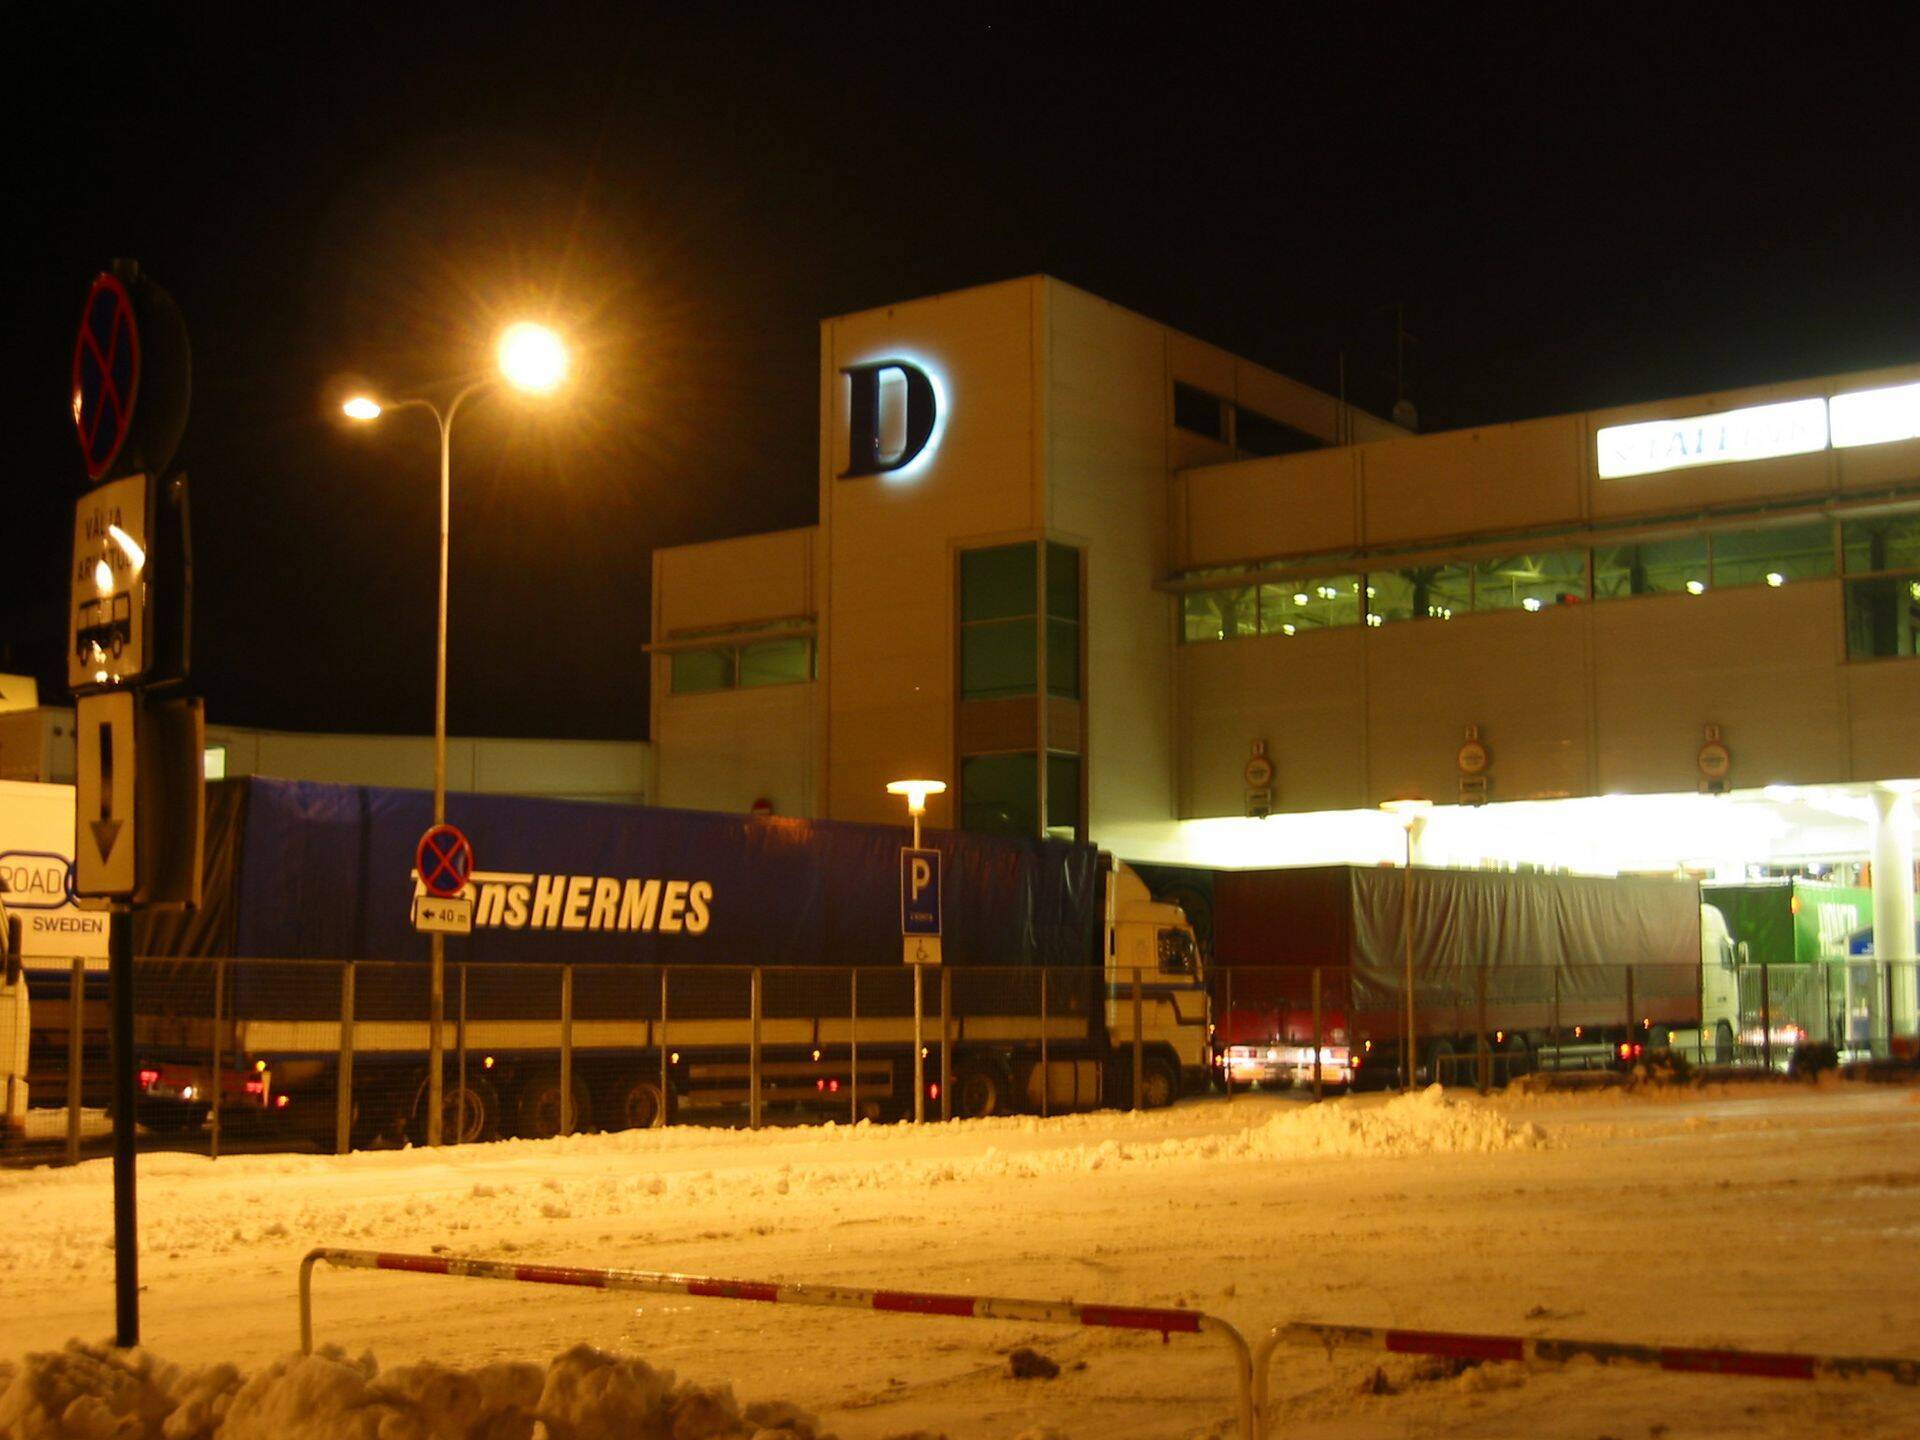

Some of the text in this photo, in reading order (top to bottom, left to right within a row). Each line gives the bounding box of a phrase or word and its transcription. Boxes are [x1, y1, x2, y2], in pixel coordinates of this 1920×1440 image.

[836, 358, 938, 480] D
[911, 857, 931, 901] P
[410, 869, 714, 936] nsHERMES
[439, 907, 455, 922] 40
[33, 916, 103, 934] SWEDEN
